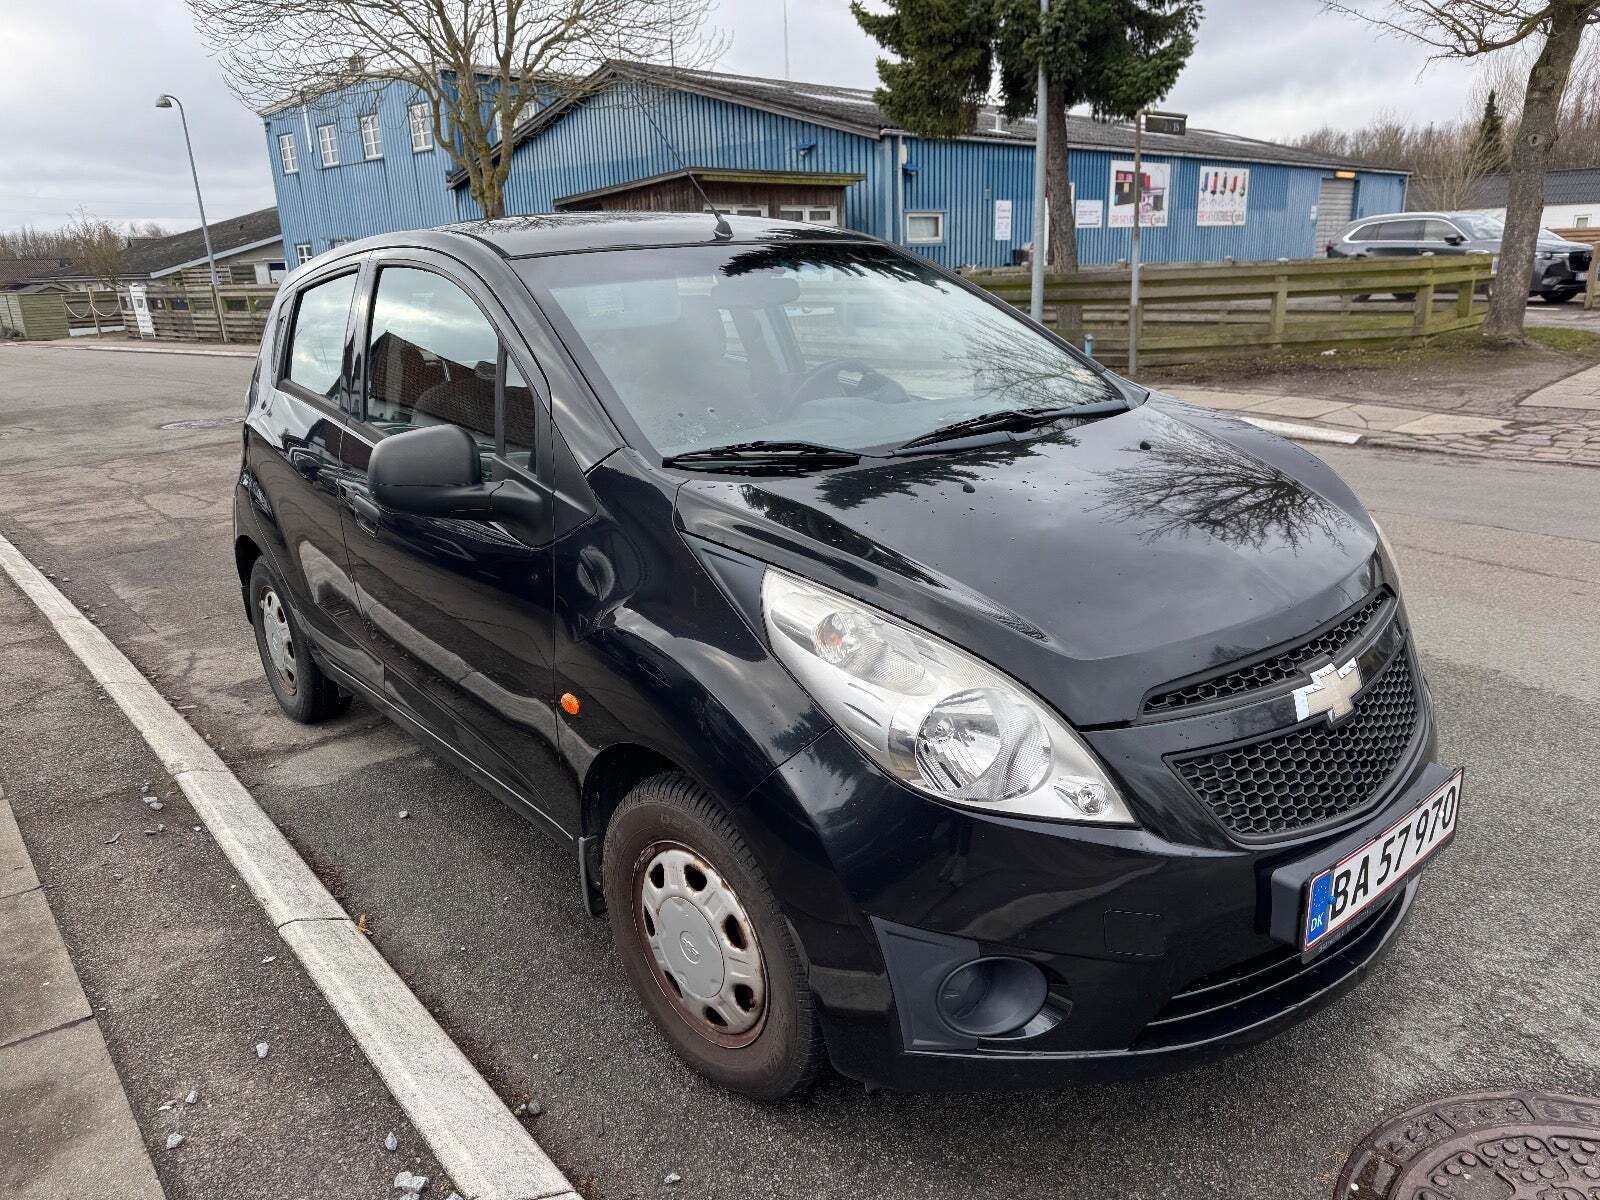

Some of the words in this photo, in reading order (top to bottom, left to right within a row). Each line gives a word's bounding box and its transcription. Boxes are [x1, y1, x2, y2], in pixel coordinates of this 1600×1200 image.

[1330, 854, 1369, 921] BA
[1376, 823, 1411, 886] 57
[1415, 786, 1456, 856] 970
[1310, 912, 1325, 932] DK
